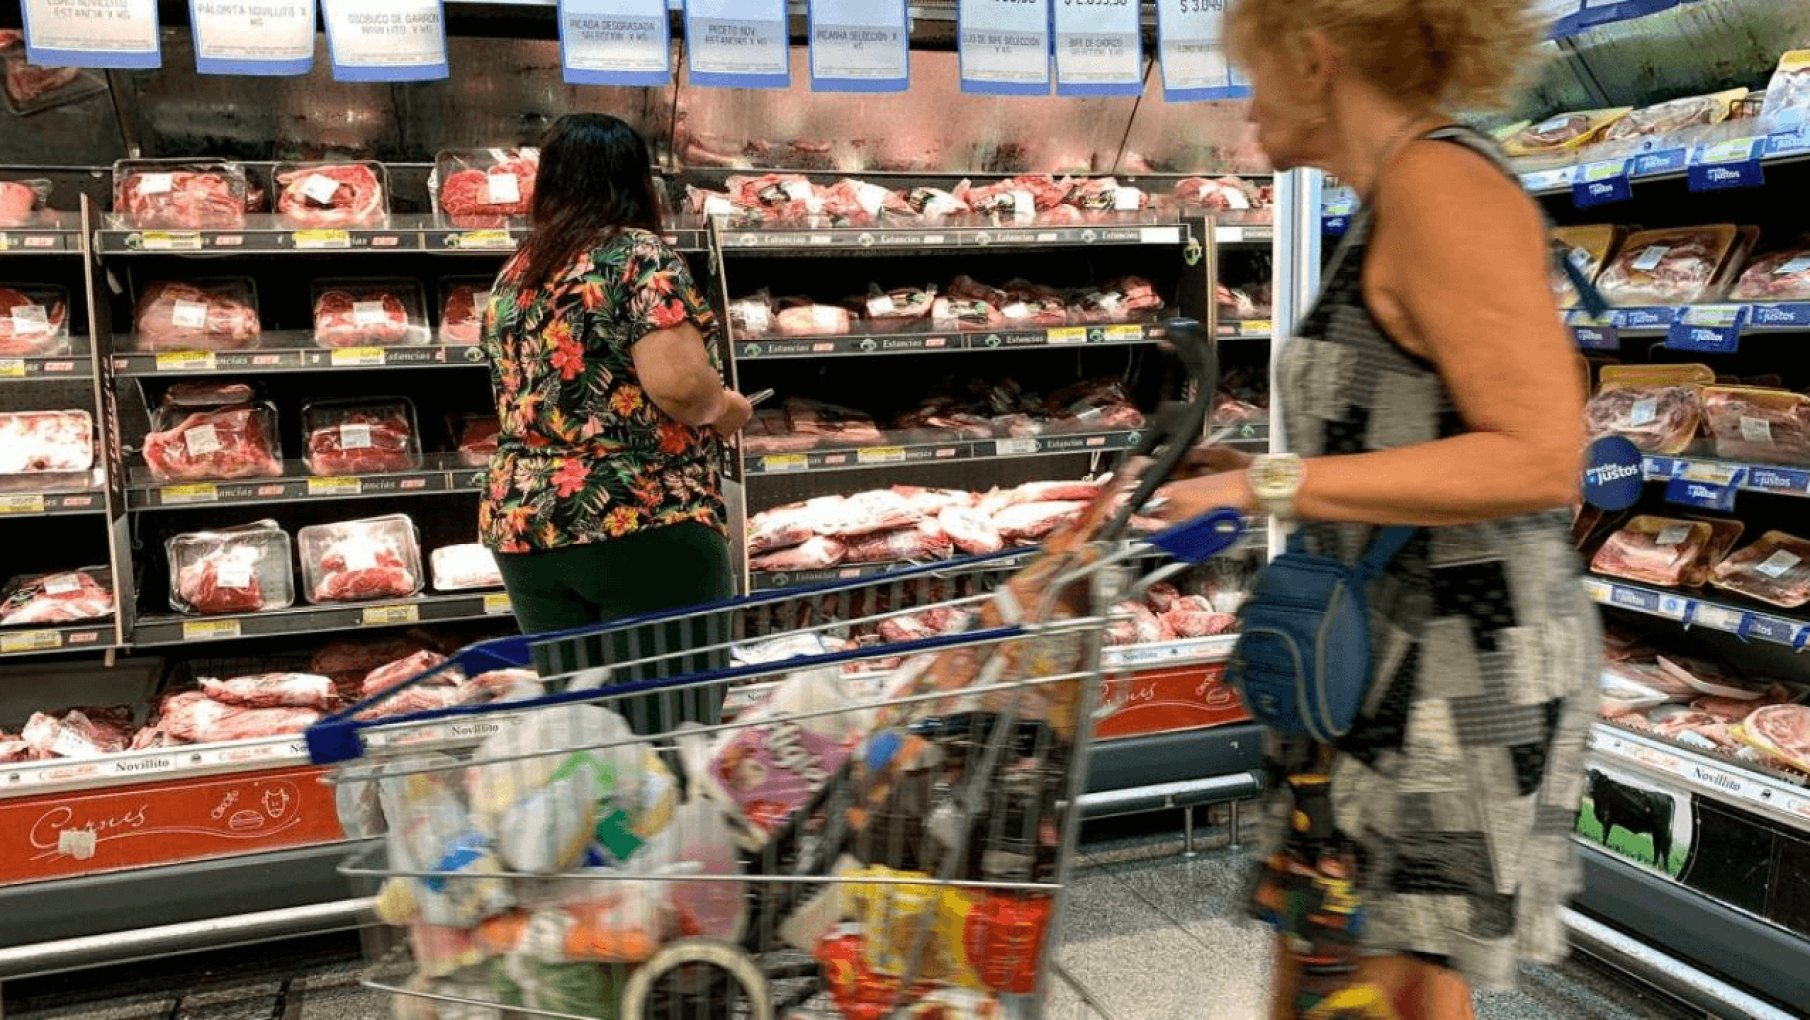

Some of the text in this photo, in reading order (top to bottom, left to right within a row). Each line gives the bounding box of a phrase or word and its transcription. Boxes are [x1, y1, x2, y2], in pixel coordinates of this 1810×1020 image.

[1598, 464, 1638, 487] justos
[115, 758, 170, 773] Novillito
[1694, 767, 1741, 791] Novillito
